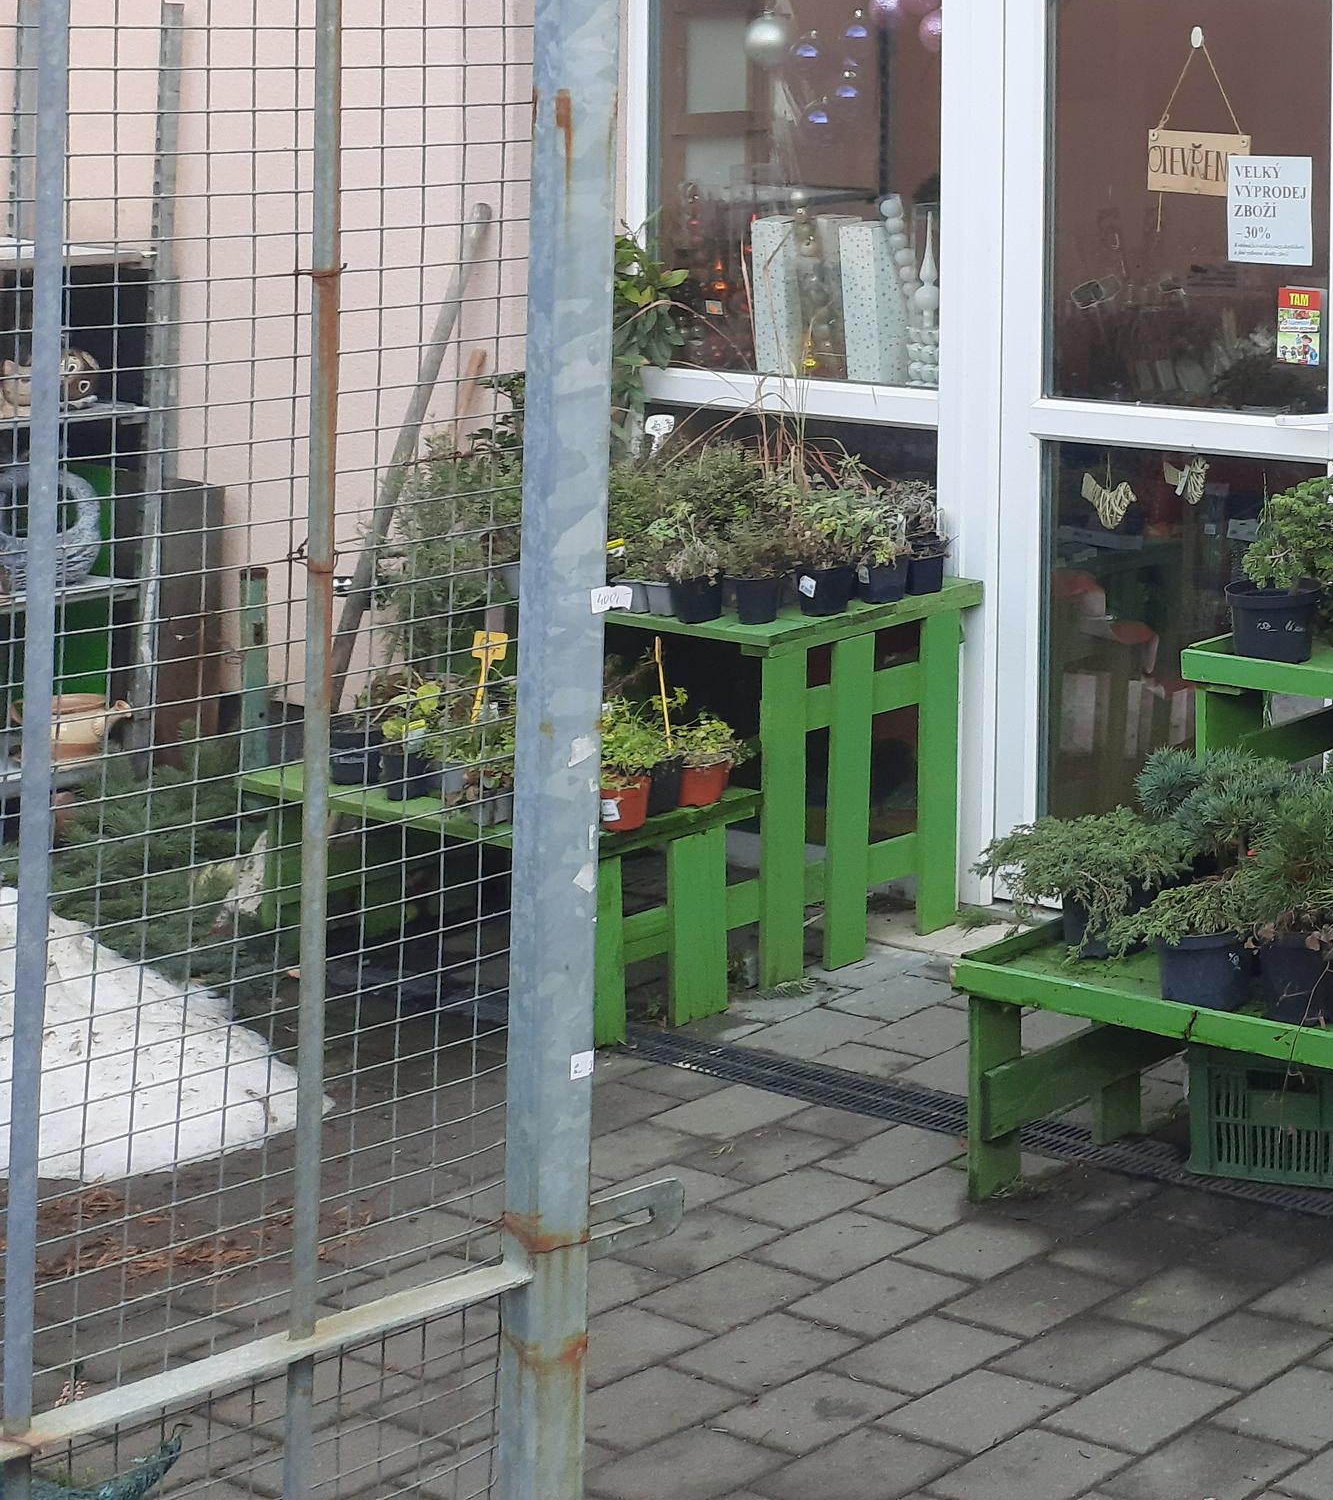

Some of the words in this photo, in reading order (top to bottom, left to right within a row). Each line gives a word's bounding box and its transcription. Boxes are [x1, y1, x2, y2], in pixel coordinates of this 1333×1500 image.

[1149, 143, 1238, 182] OTEVŘEN
[1234, 163, 1282, 179] VELKÝ
[1234, 182, 1307, 199] VÝPRODEJ
[1234, 202, 1277, 218] ZBOŽÍ
[1289, 293, 1310, 306] TAM
